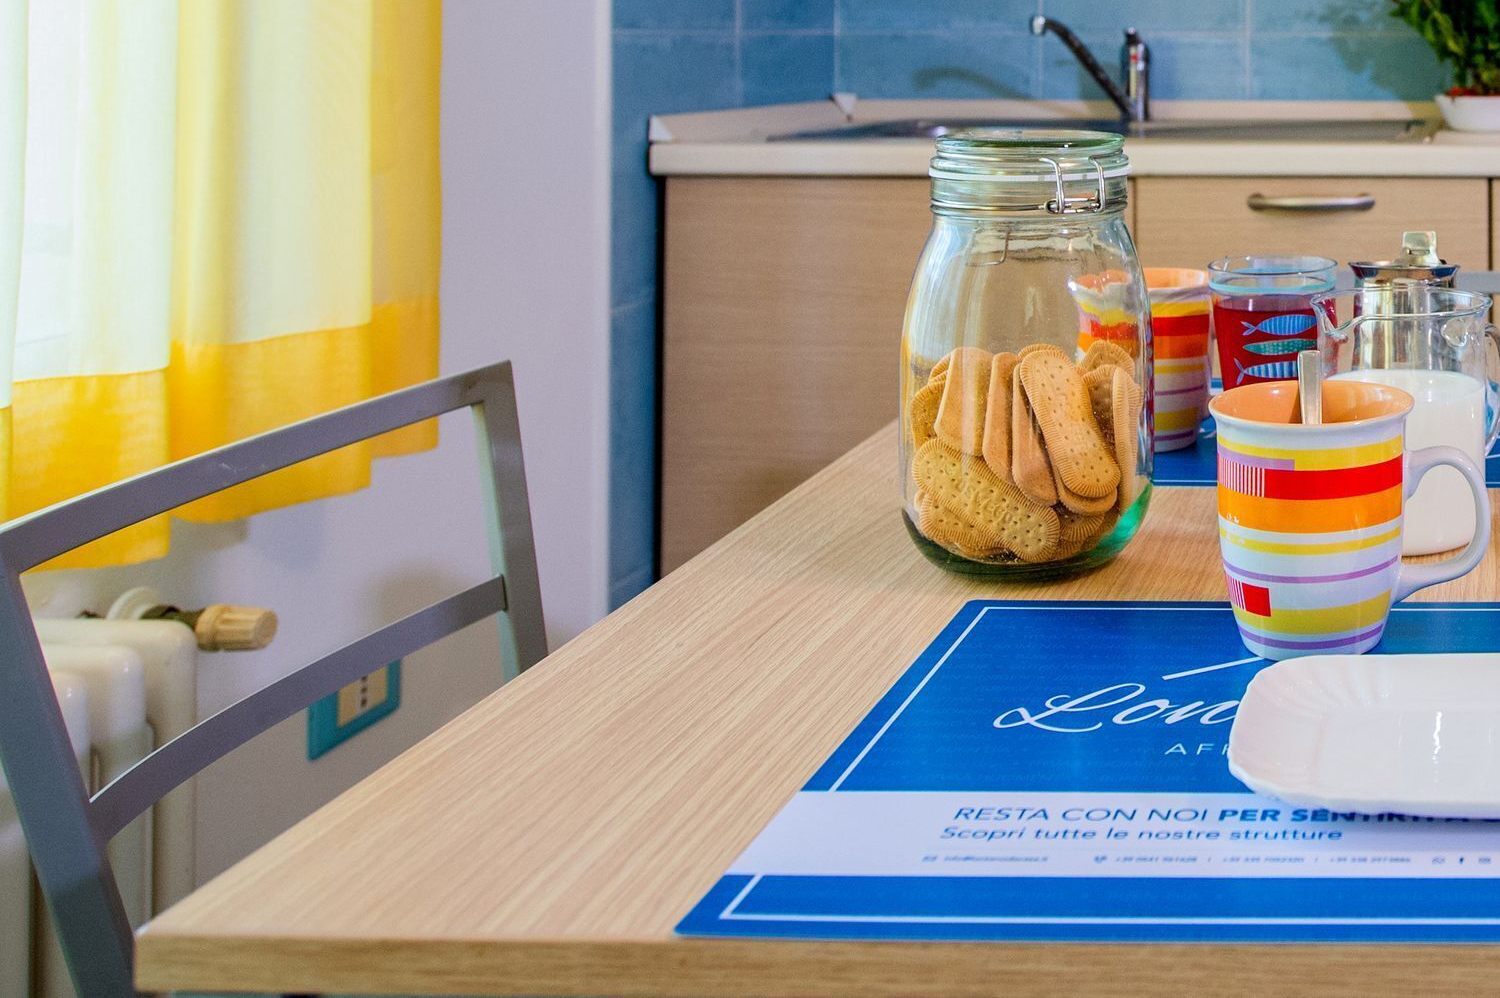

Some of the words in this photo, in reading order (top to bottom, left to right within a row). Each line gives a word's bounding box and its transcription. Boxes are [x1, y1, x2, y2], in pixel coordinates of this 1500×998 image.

[993, 682, 1239, 733] Lon
[1165, 742, 1230, 755] AF
[953, 807, 1049, 821] RESTA
[1061, 807, 1136, 821] CON
[1148, 807, 1209, 821] NOI
[1218, 808, 1281, 822] PER
[939, 825, 1026, 842] Scopri
[1034, 827, 1096, 840] tutte
[1106, 827, 1128, 840] le
[1138, 829, 1221, 840] nostre
[1229, 828, 1344, 841] strutture
